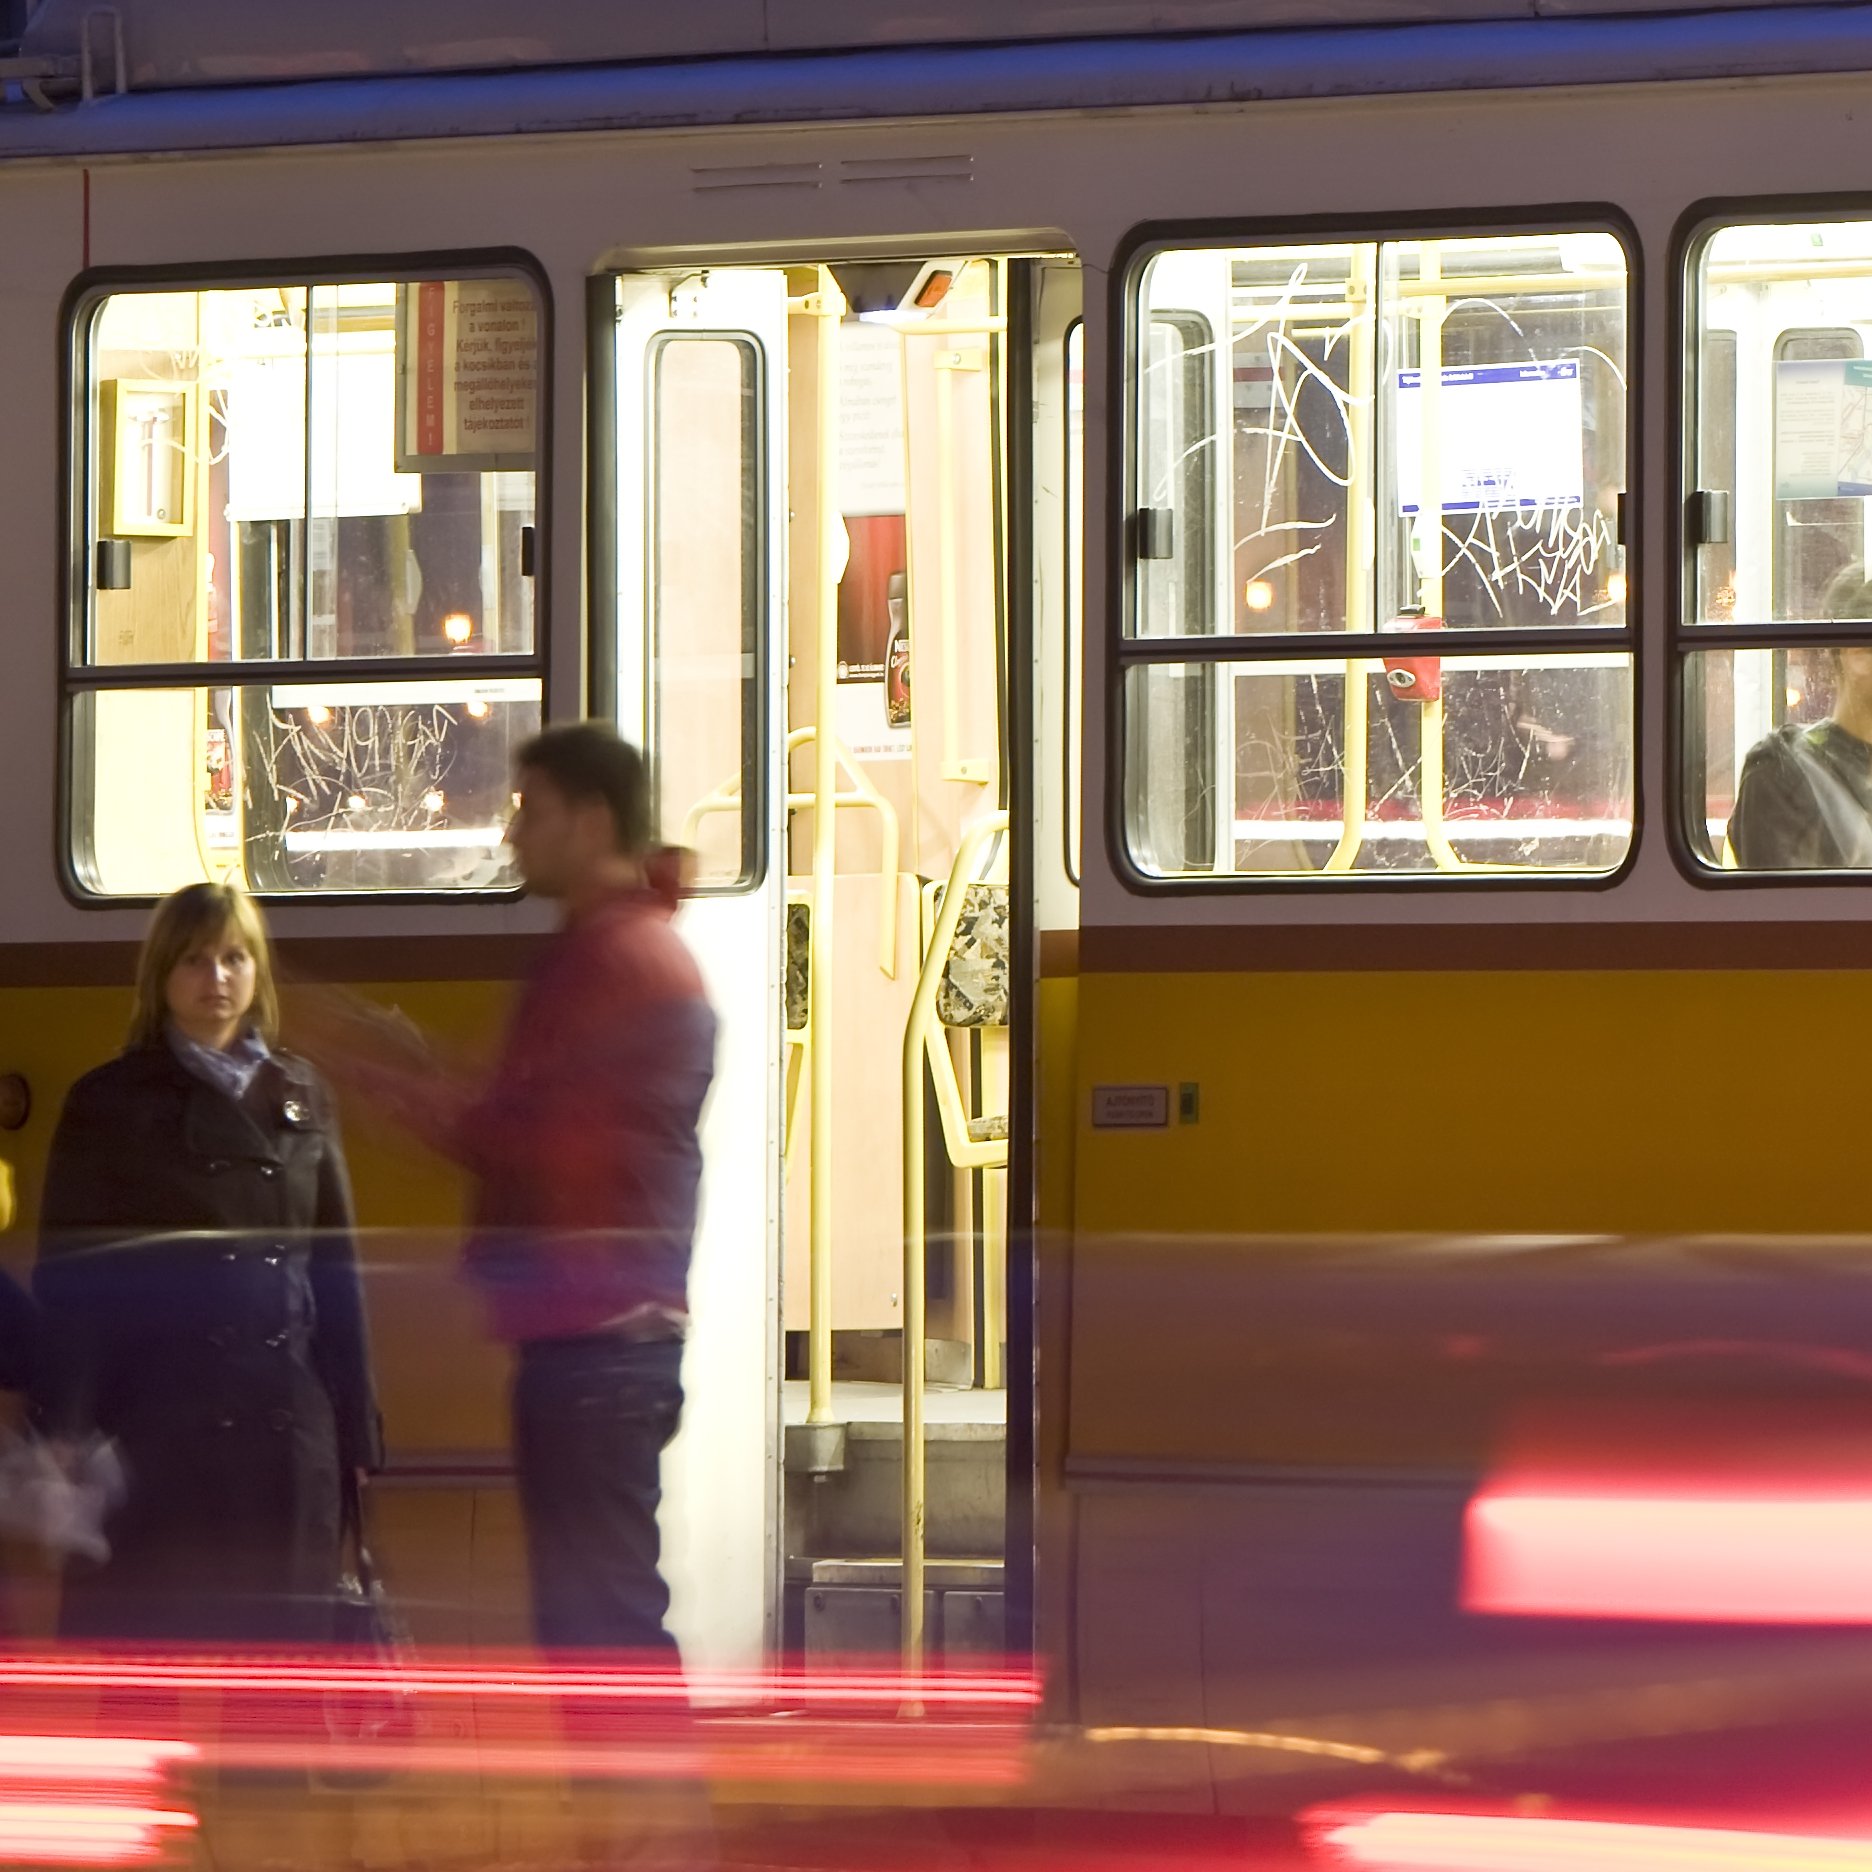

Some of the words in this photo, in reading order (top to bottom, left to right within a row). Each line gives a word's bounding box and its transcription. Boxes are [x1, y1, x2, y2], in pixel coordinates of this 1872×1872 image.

[452, 299, 498, 317] Forgalmi
[463, 356, 515, 372] kocsikban
[469, 396, 525, 413] elhelyezett
